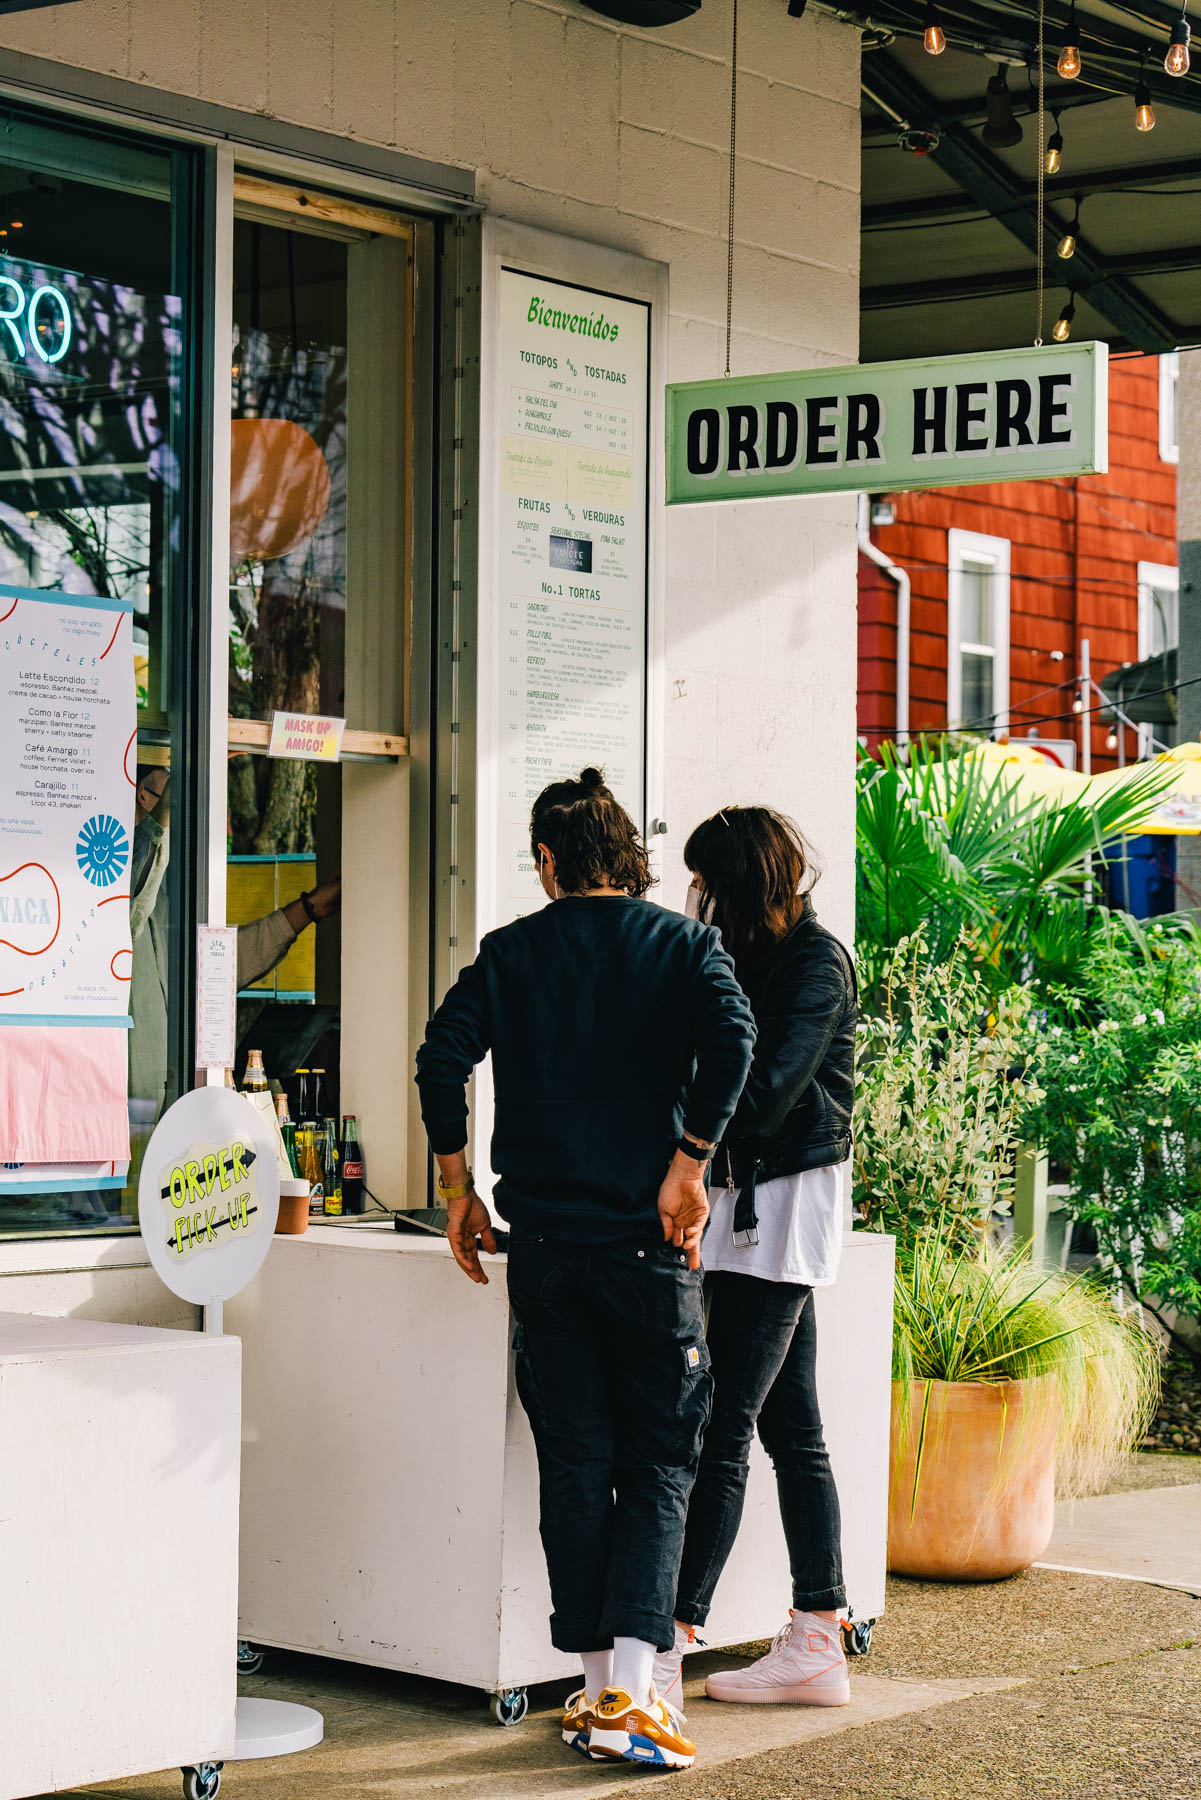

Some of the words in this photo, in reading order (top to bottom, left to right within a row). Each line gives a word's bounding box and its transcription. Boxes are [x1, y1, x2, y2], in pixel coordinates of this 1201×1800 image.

[527, 296, 620, 342] Bienvenidos
[519, 350, 558, 369] TOTOPOS
[566, 358, 578, 377] AND
[584, 365, 627, 385] TOSTADAS
[686, 393, 886, 479] ORDER
[911, 373, 1076, 461] HERE
[518, 497, 551, 513] FRUTAS
[565, 503, 575, 521] AND
[583, 509, 625, 526] VERDURAS
[541, 582, 563, 596] No.1
[569, 586, 601, 601] TORTAS
[19, 671, 41, 680] Latte
[43, 673, 86, 684] Escondido
[90, 678, 100, 686] 12
[52, 685, 75, 693] Banhez
[83, 697, 111, 705] horchata
[28, 707, 51, 717] Como
[53, 710, 61, 718] la
[62, 710, 78, 719] Flor
[81, 712, 90, 720] 12
[50, 720, 73, 728] Banhez
[285, 718, 314, 734] MASK
[316, 721, 331, 735] UP
[24, 727, 45, 735] sherry
[67, 731, 93, 739] steamer
[25, 743, 45, 753] Café
[46, 746, 78, 756] Amargo
[83, 748, 91, 757] 11
[286, 737, 324, 753] AMIGO!
[47, 756, 68, 764] Fernet
[34, 781, 67, 791] Carajillo
[71, 783, 79, 791] 11
[47, 792, 70, 800] Banhez
[59, 801, 82, 809] shaken
[0, 896, 51, 925] VACA
[170, 1142, 249, 1208] ORDER
[175, 1192, 251, 1253] PICK-UP
